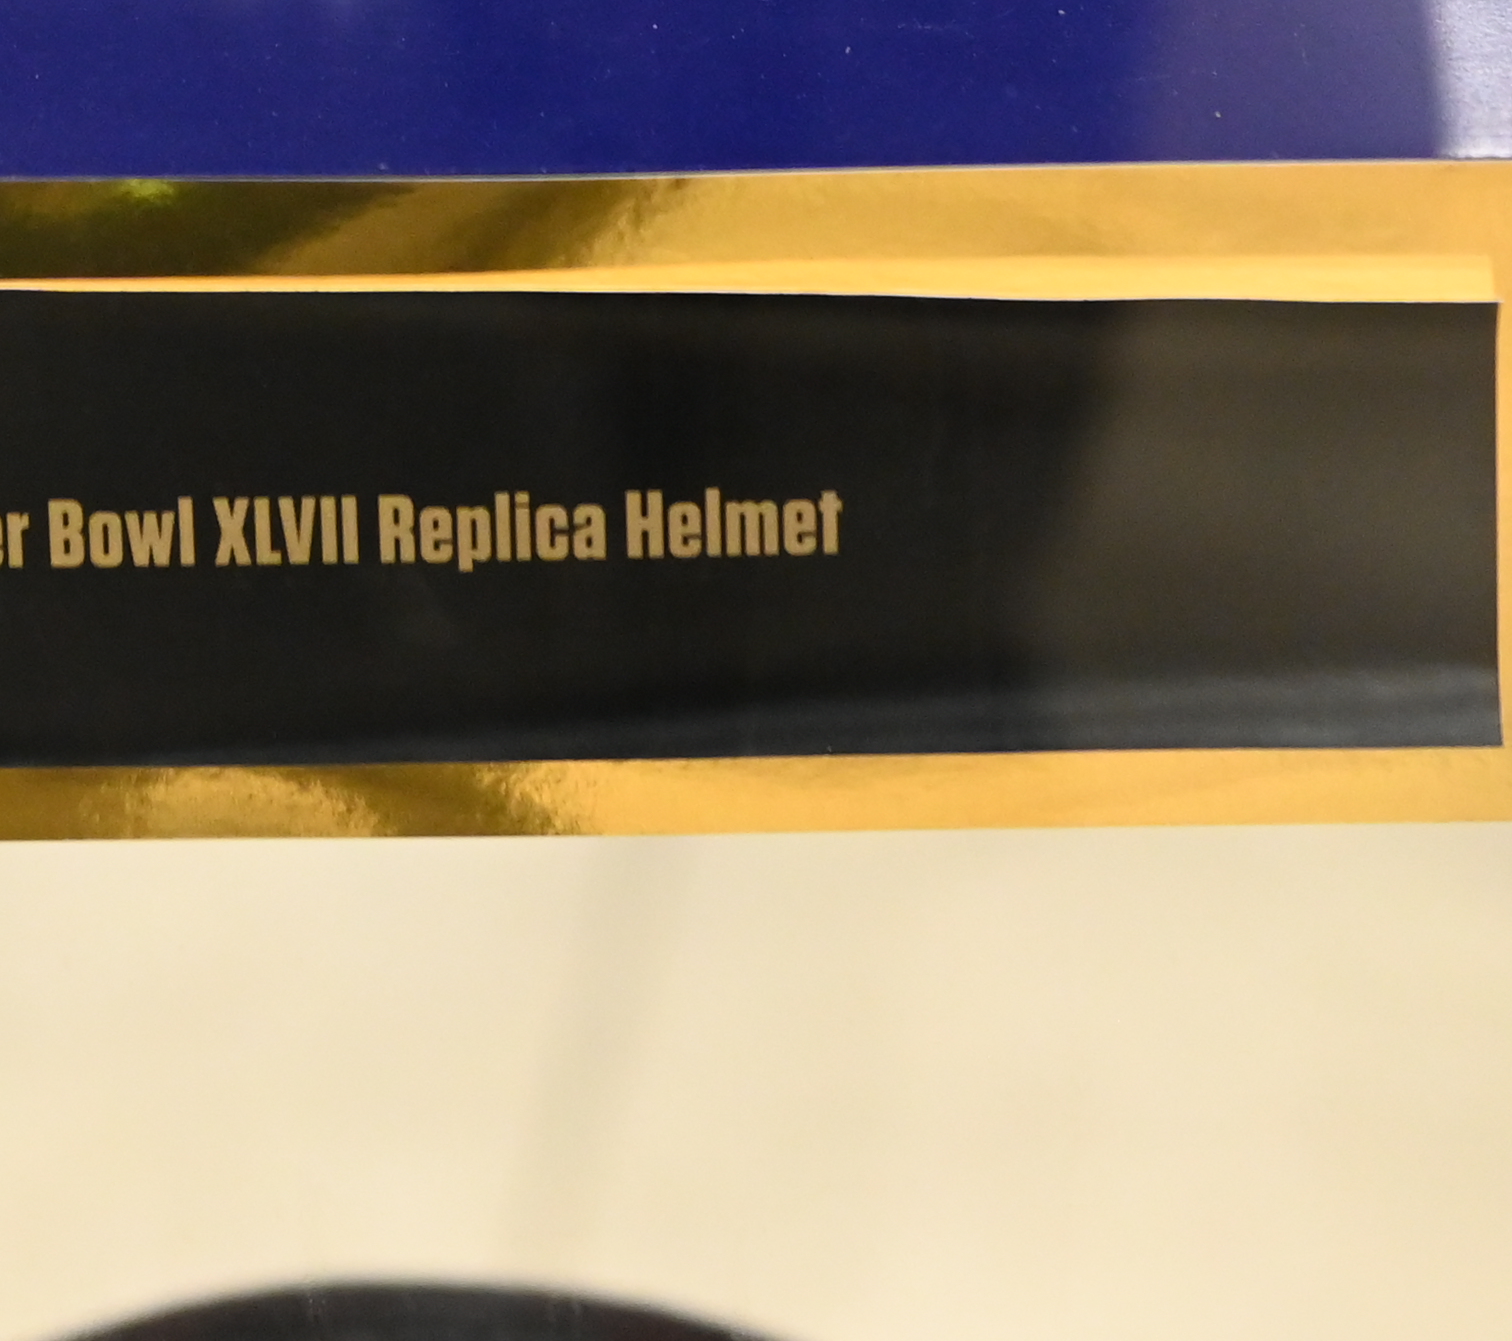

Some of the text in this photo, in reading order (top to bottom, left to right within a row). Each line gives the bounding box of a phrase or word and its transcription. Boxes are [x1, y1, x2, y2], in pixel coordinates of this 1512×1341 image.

[47, 496, 198, 569] Bowl
[212, 494, 360, 567] XLVII
[377, 490, 608, 573] Replica
[625, 487, 844, 560] Helmet
